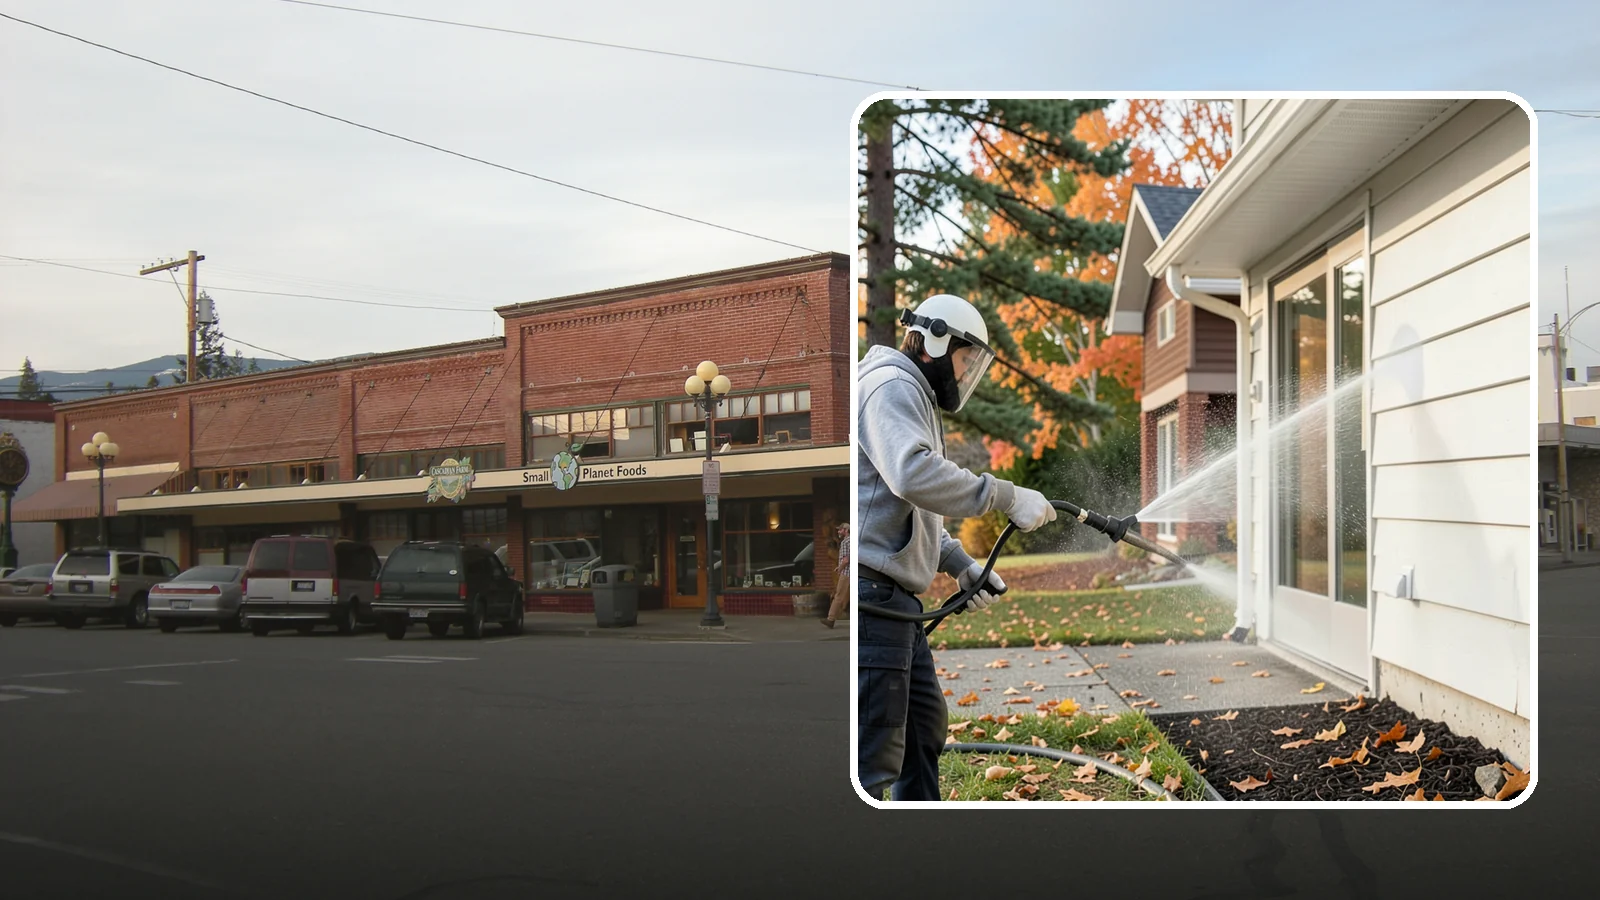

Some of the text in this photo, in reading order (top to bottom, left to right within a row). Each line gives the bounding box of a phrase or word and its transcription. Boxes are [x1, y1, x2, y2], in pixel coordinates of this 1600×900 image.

[523, 464, 647, 483] Small Planet Foods
